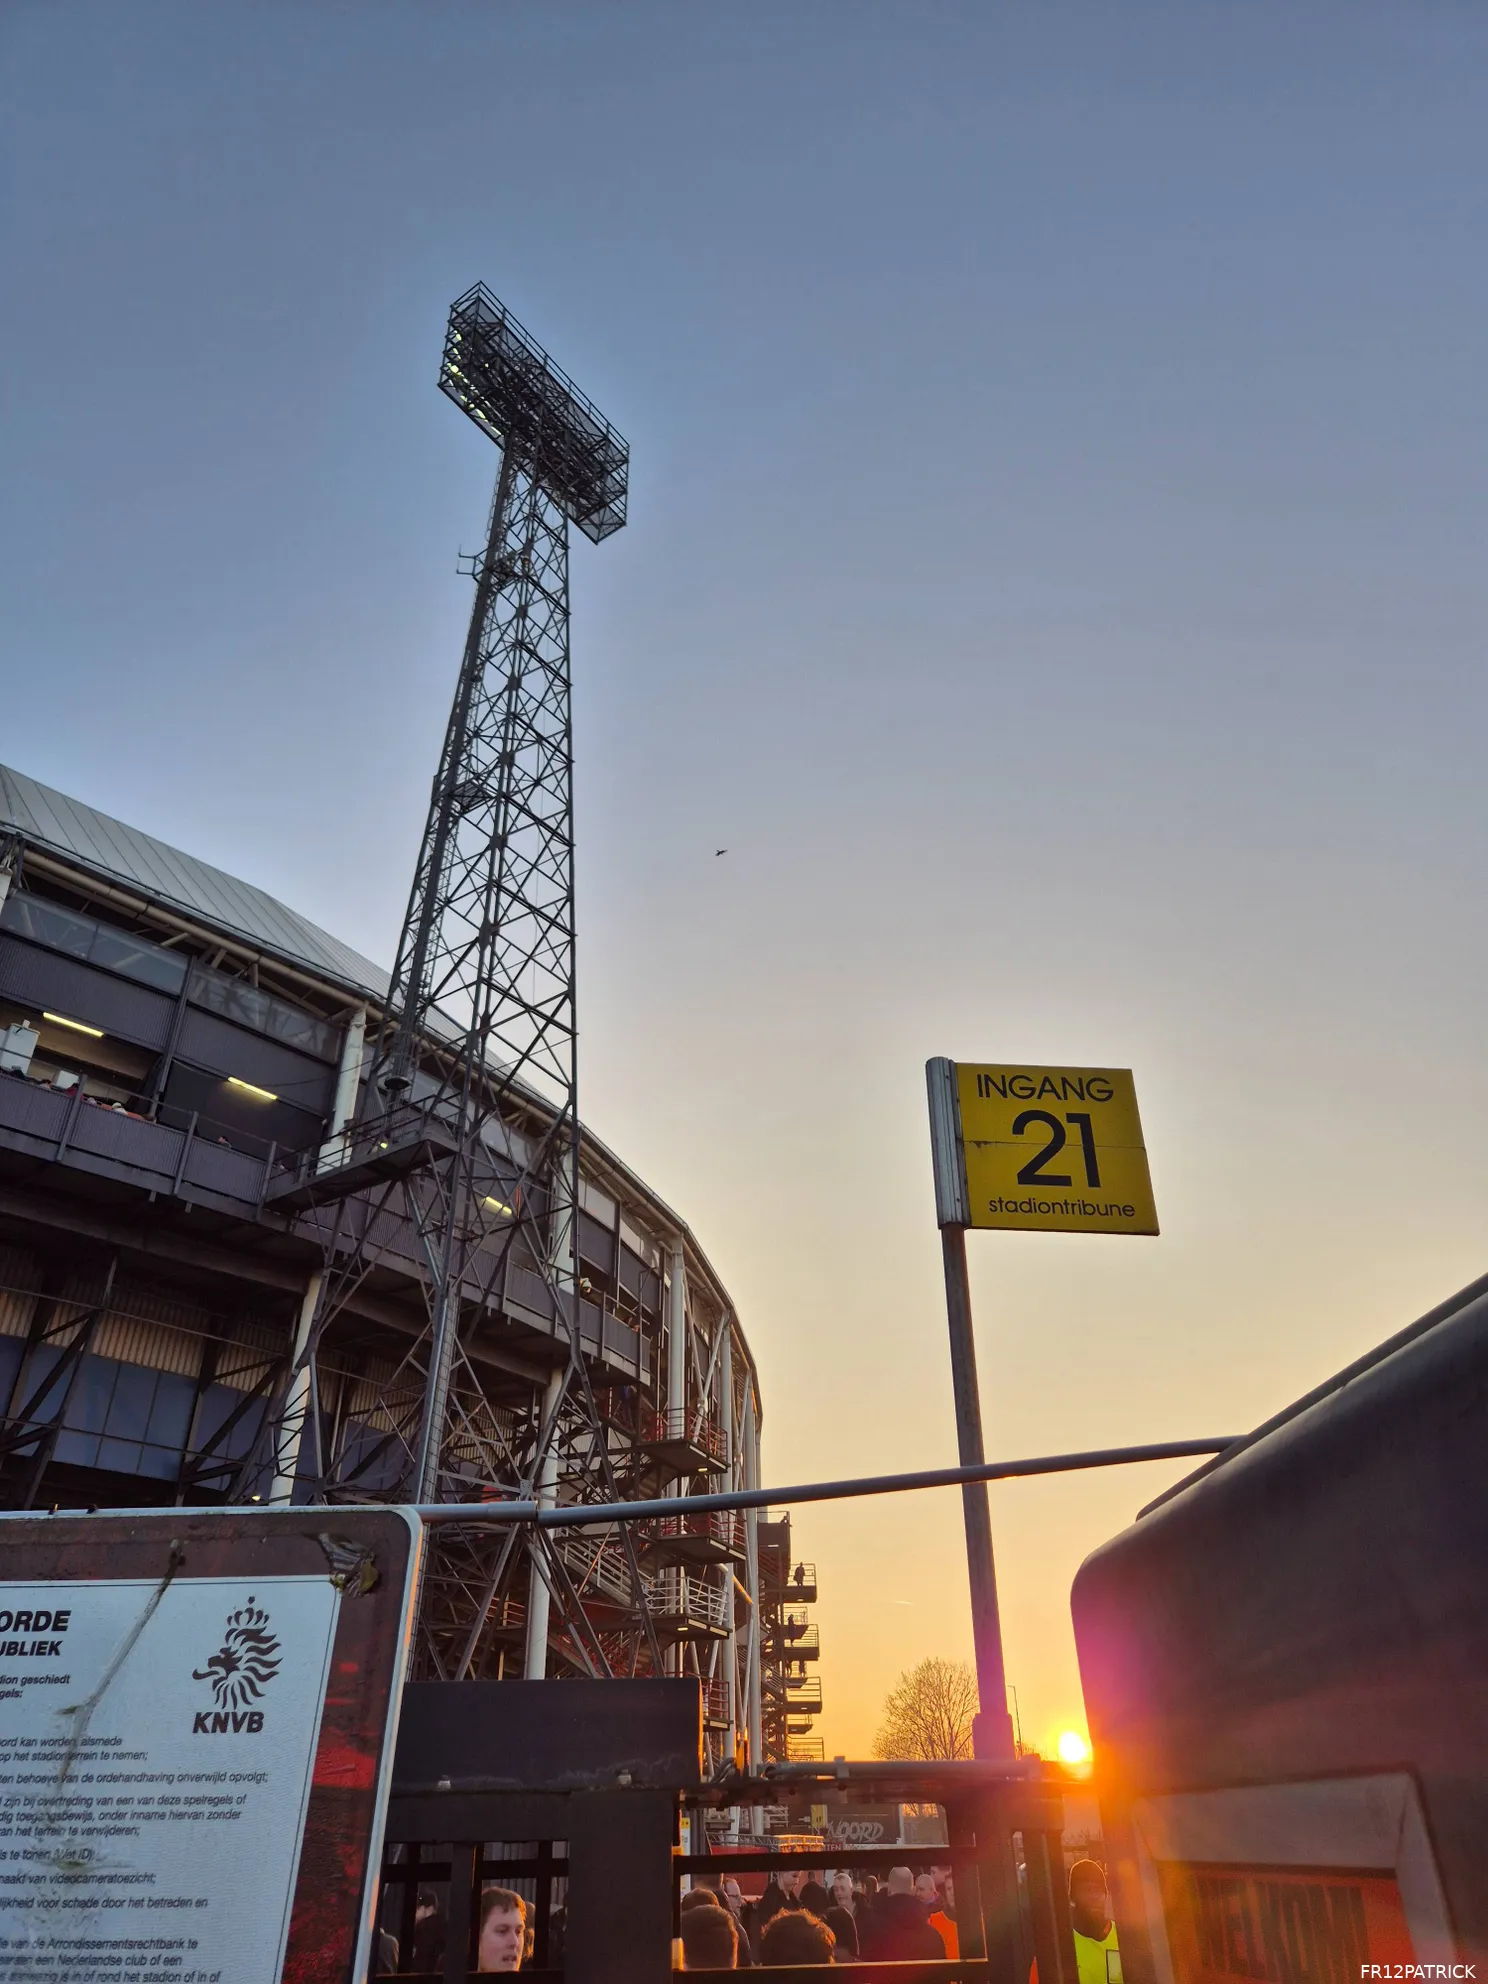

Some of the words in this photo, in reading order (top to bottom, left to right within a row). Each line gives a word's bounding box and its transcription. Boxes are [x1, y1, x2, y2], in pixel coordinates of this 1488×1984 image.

[976, 1073, 1114, 1102] INGANG
[1012, 1109, 1102, 1188] 21
[988, 1196, 1136, 1217] stadiontribune
[20, 1674, 71, 1687] geschiedt
[192, 1711, 265, 1734] KNVB
[20, 1737, 37, 1747] kan
[81, 1736, 122, 1747] alsmede
[14, 1752, 29, 1761] het
[100, 1750, 110, 1760] te
[16, 1773, 59, 1784] behoeve
[81, 1772, 93, 1783] de
[96, 1772, 174, 1785] ordehandhaving
[177, 1772, 227, 1784] onverwijld
[23, 1796, 36, 1809] bij
[96, 1797, 113, 1806] van
[116, 1797, 134, 1806] een
[137, 1797, 154, 1806] van
[157, 1795, 180, 1806] deze
[236, 1794, 247, 1805] of
[98, 1811, 127, 1821] onder
[130, 1809, 166, 1821] inname
[169, 1809, 204, 1821] hiervan
[207, 1809, 241, 1820] zonder
[15, 1826, 31, 1836] het
[68, 1826, 78, 1836] te
[10, 1849, 19, 1860] te
[22, 1848, 50, 1860] tonen
[29, 1875, 47, 1884] van
[37, 1898, 59, 1909] voor
[62, 1897, 98, 1909] schade
[101, 1896, 126, 1908] door
[128, 1896, 145, 1908] het
[147, 1896, 192, 1908] betreden
[195, 1898, 209, 1908] en
[47, 1937, 185, 1950] Arrondissementsrechtbank
[188, 1938, 198, 1950] te
[58, 1953, 122, 1966] Nederlandse
[125, 1954, 147, 1966] club
[150, 1954, 162, 1966] of
[163, 1956, 182, 1967] een
[84, 1970, 96, 1982] of
[98, 1970, 122, 1983] rond
[123, 1970, 140, 1983] het
[142, 1970, 181, 1983] stadion
[184, 1970, 196, 1983] of
[197, 1970, 207, 1983] in
[209, 1970, 221, 1983] of
